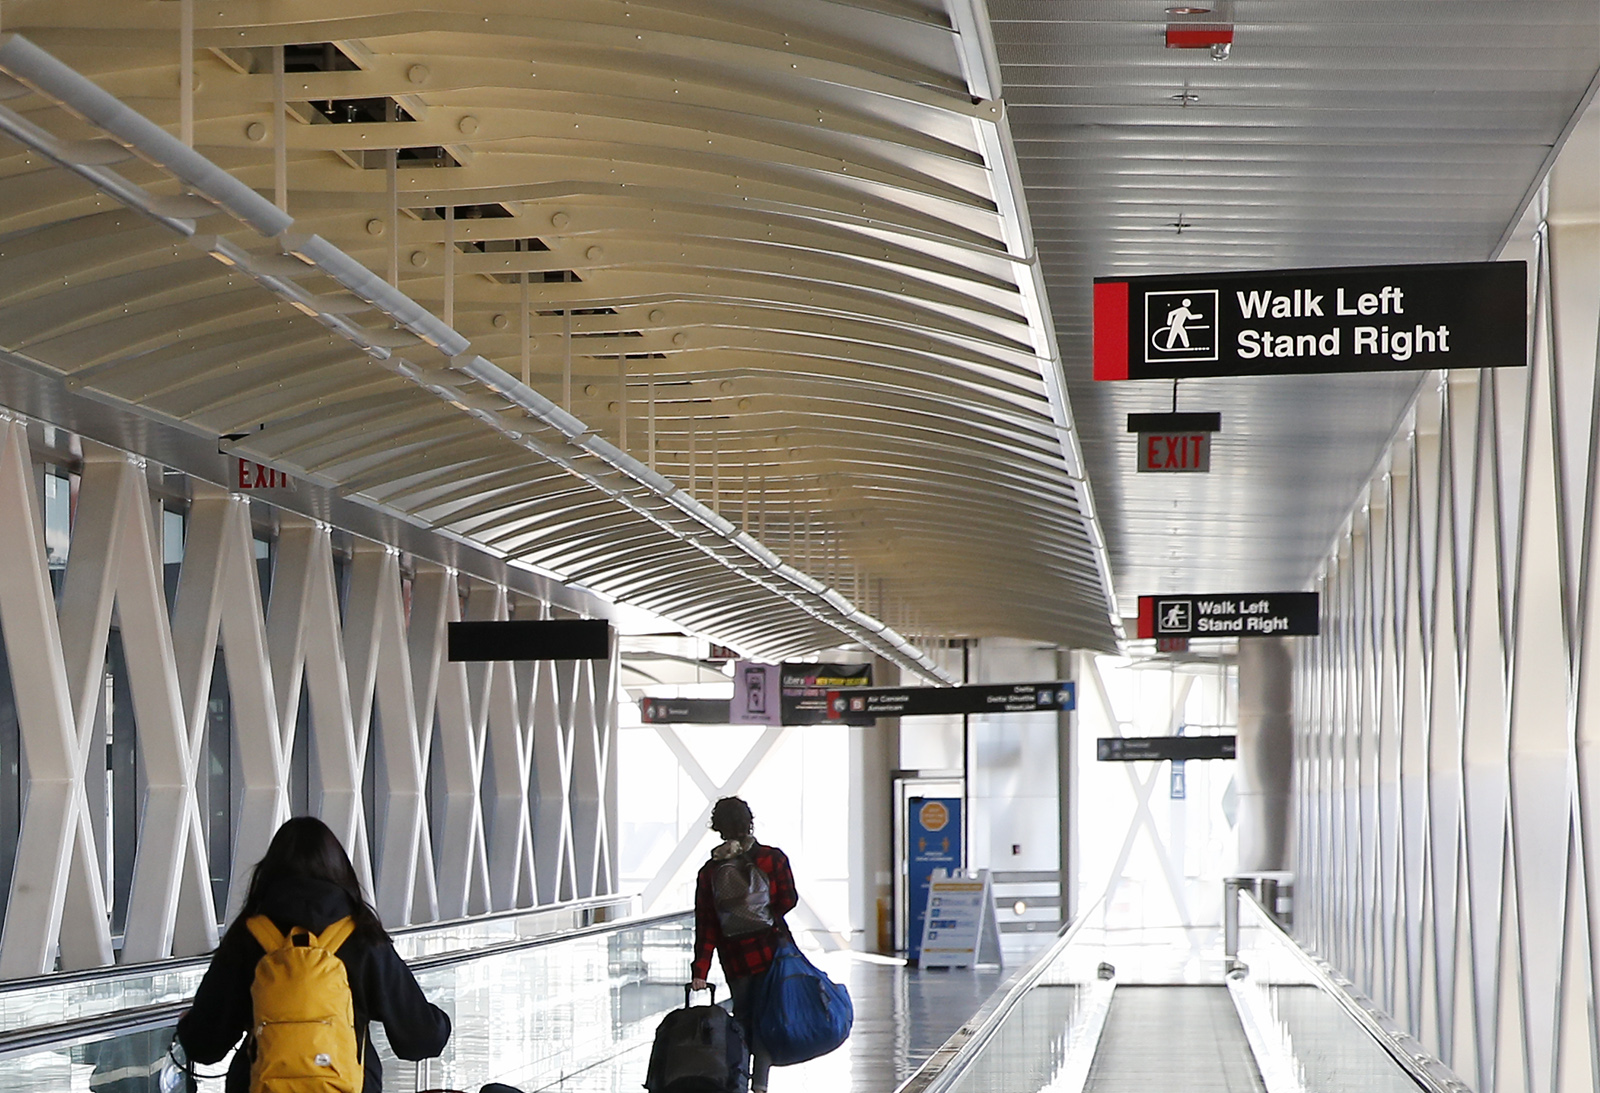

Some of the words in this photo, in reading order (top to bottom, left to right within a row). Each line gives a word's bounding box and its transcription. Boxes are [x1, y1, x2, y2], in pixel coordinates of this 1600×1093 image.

[1237, 289, 1324, 320] Walk
[1337, 286, 1404, 317] Left
[1237, 328, 1341, 359] Stand
[1354, 324, 1450, 361] Right
[1147, 436, 1204, 469] EXIT
[1197, 600, 1236, 615] Walk
[1239, 599, 1269, 614] Left
[1197, 617, 1243, 632] Stand
[1247, 616, 1289, 634] Right
